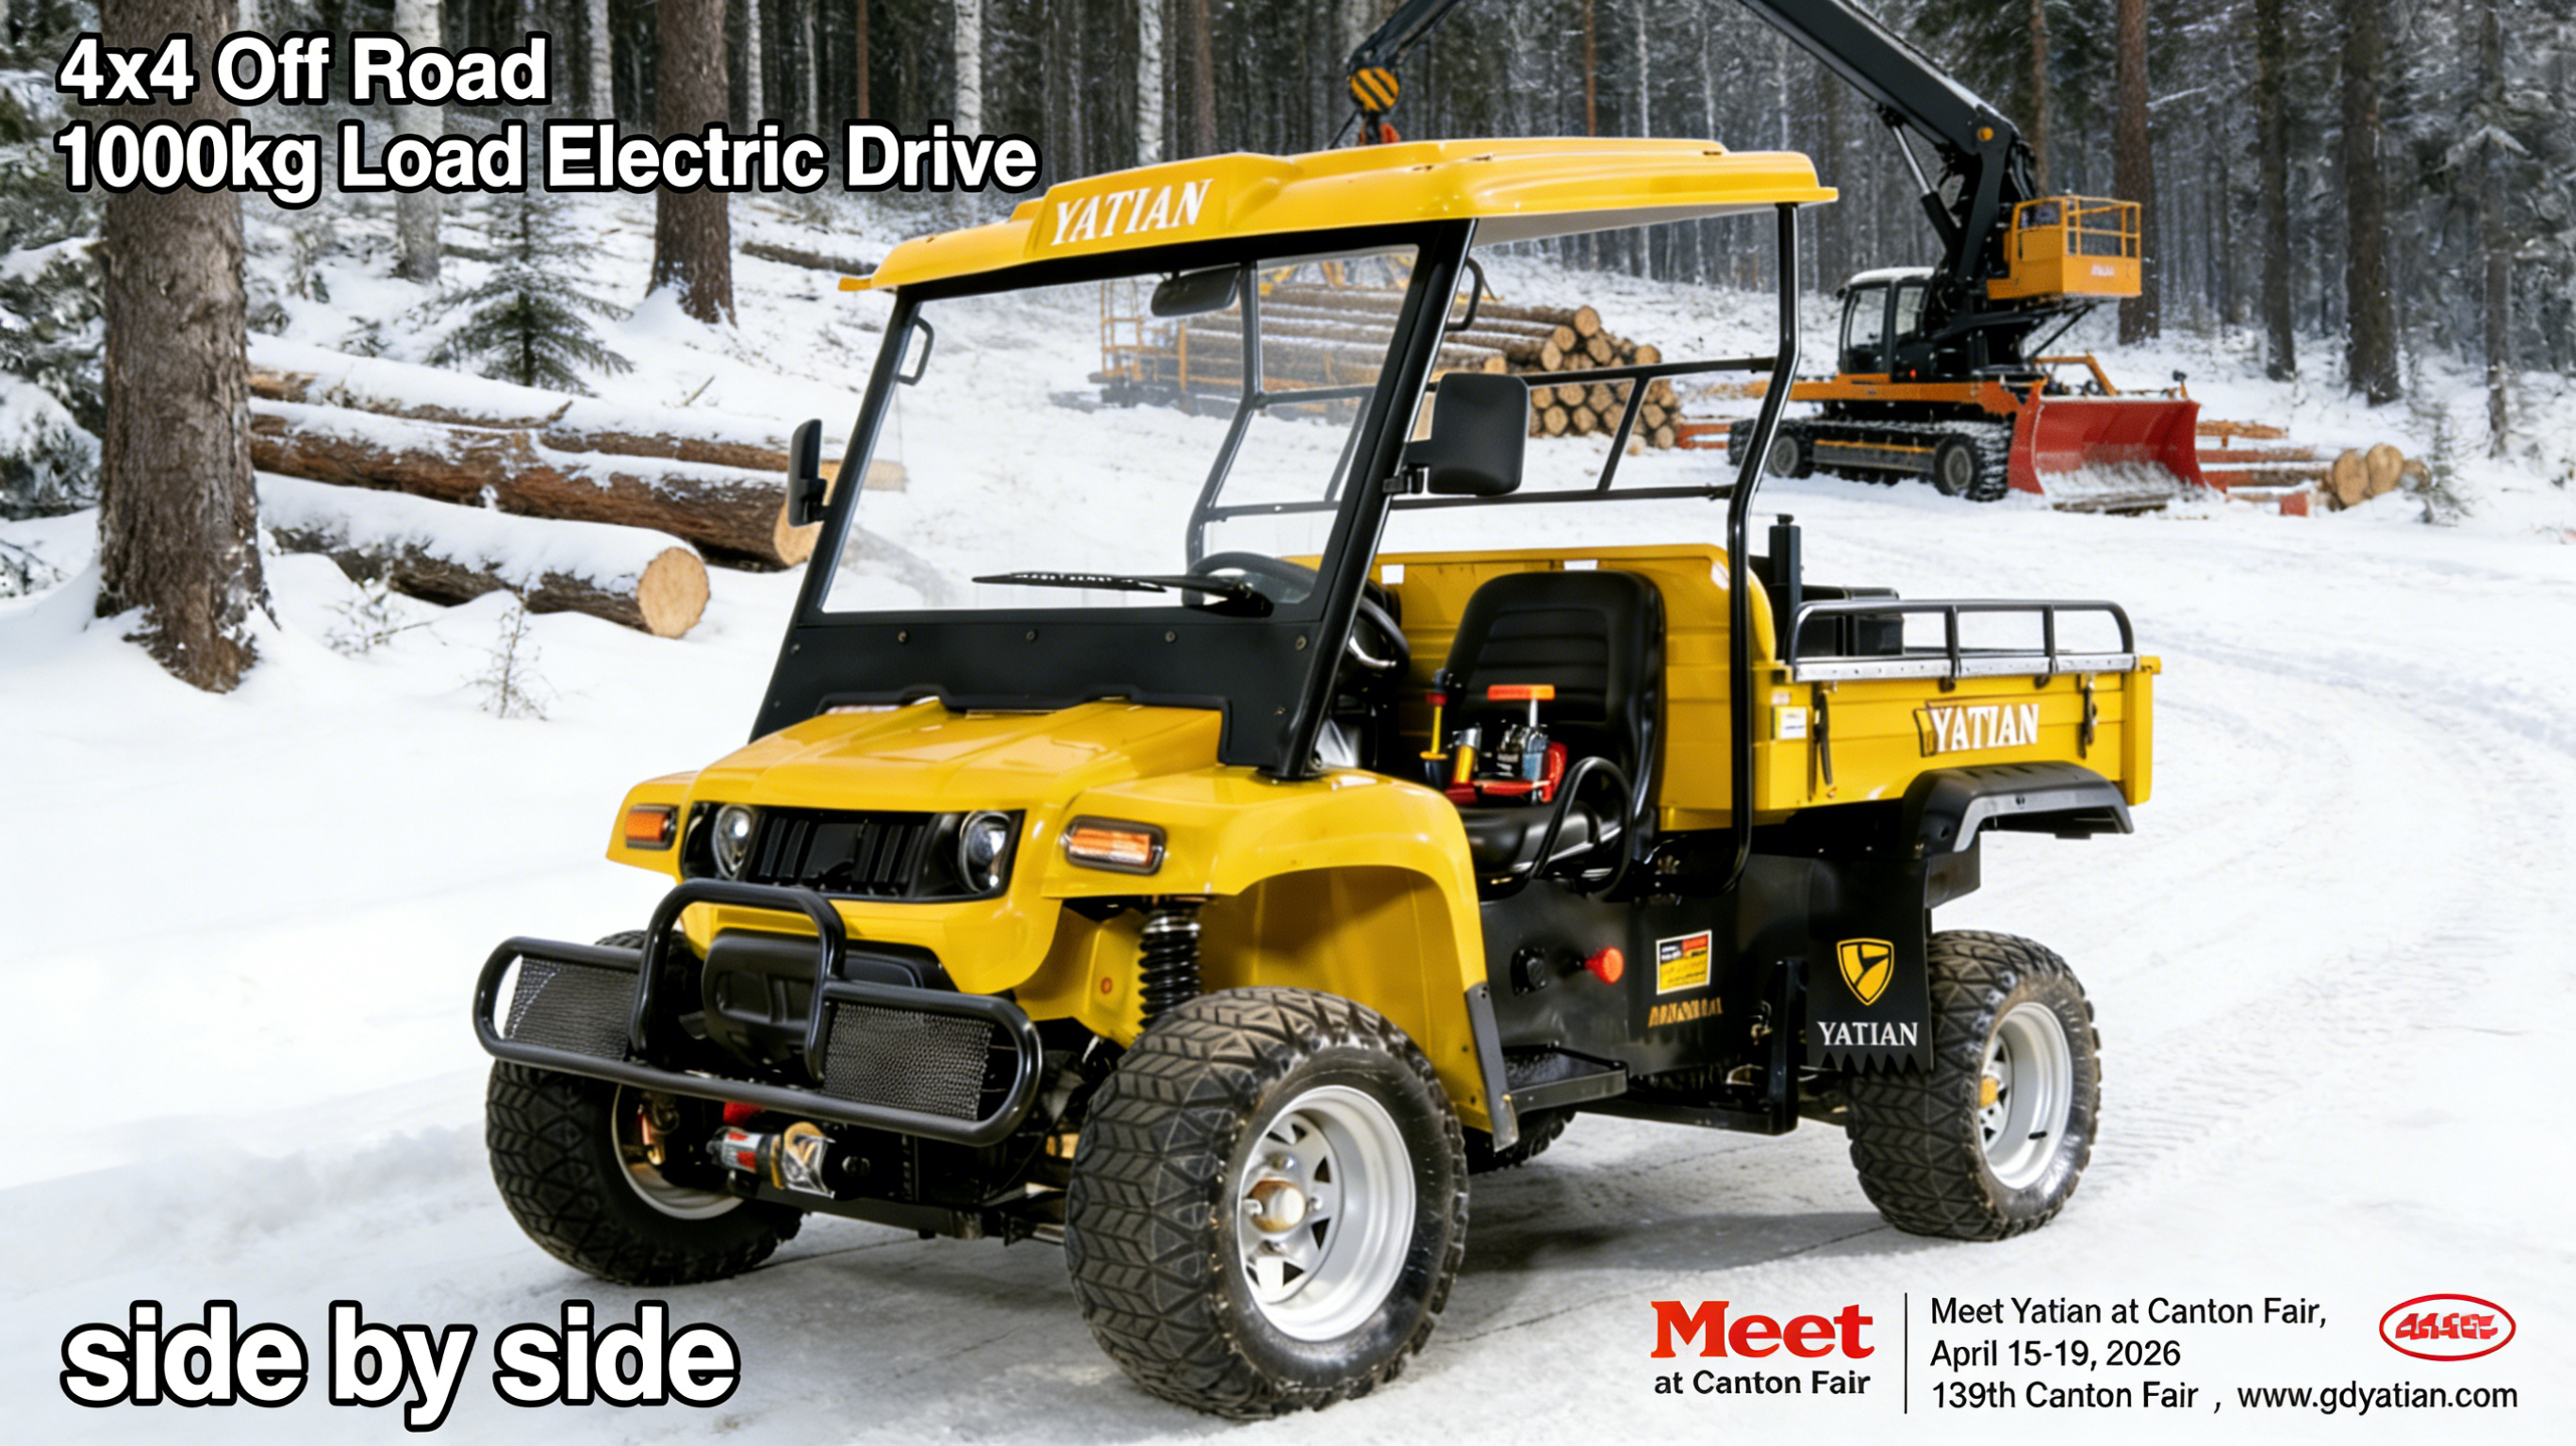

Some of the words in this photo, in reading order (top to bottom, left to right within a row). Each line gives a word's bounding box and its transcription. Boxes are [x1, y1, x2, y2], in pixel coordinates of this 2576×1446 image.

[1049, 178, 1214, 246] YATIAN
[1928, 703, 2039, 752] YATIAN
[1817, 1021, 1919, 1046] YATIAN
